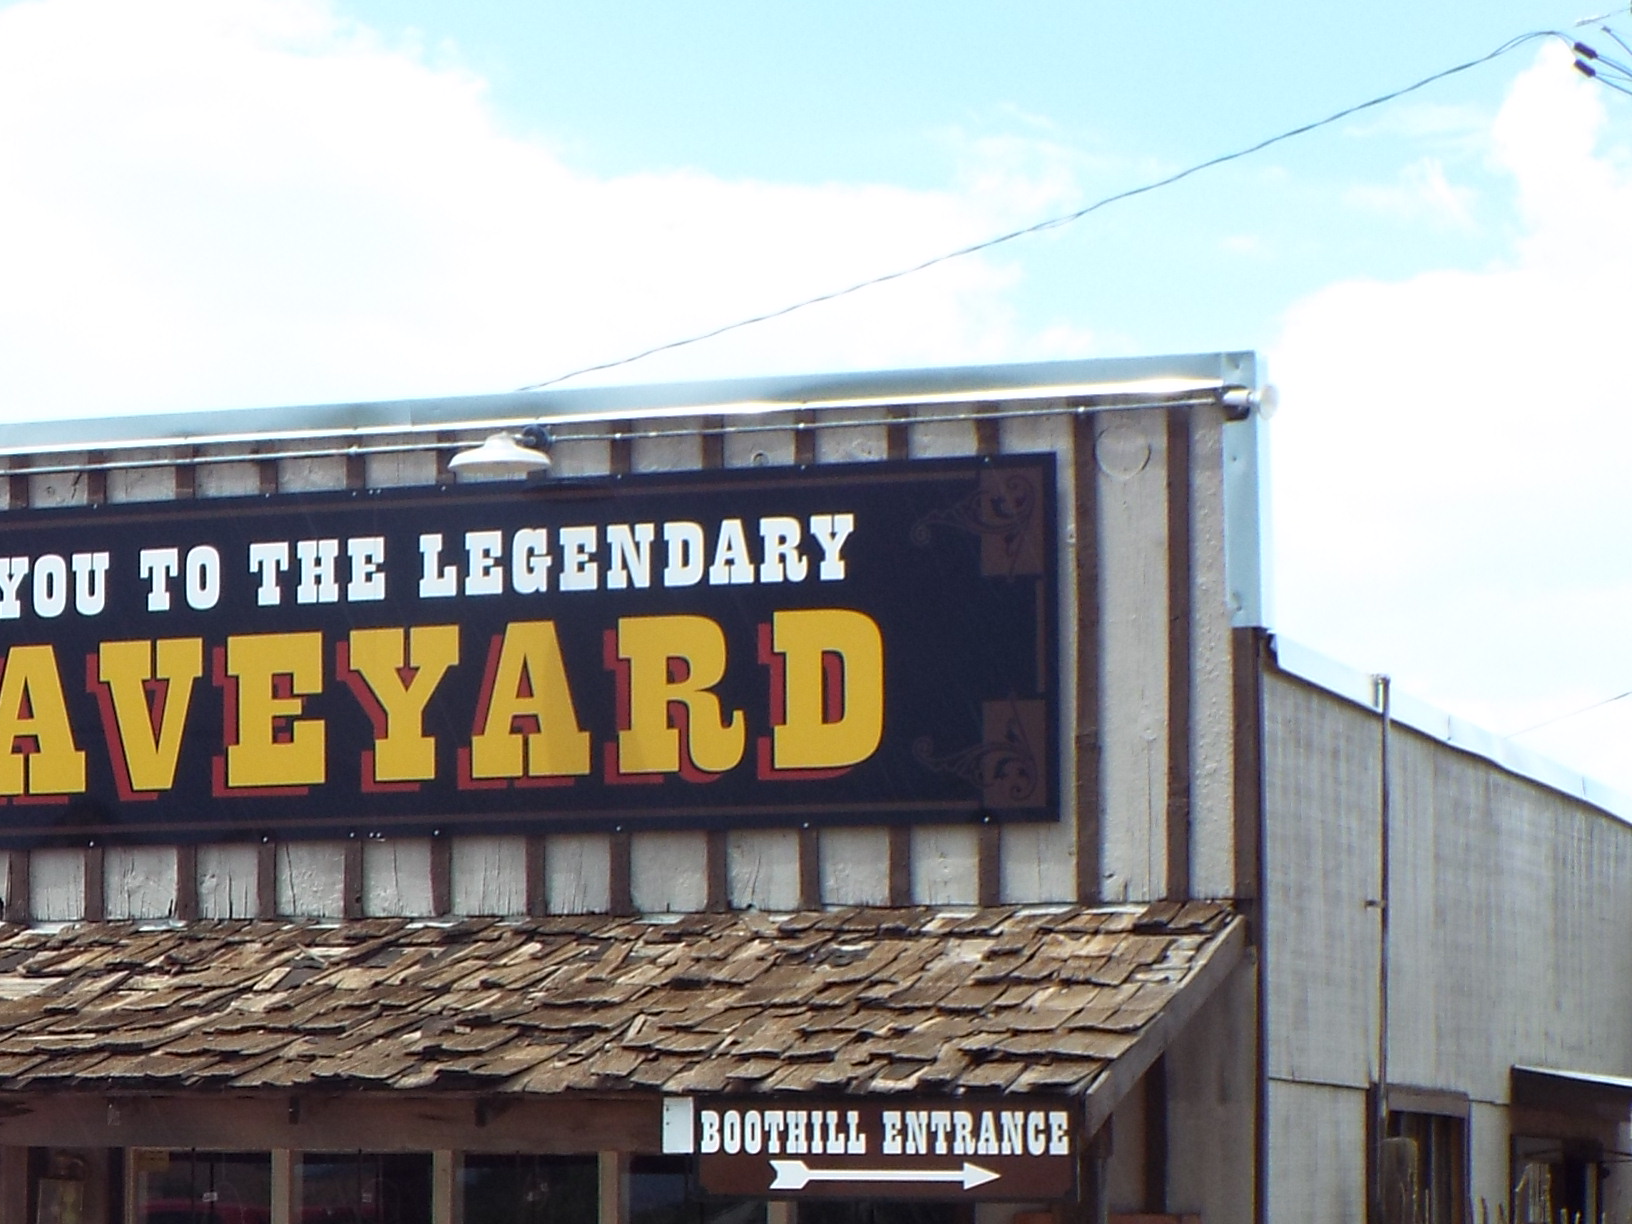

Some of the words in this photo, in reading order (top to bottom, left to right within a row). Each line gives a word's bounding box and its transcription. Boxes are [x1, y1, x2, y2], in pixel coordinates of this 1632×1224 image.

[140, 545, 221, 612] TO
[249, 536, 386, 606] THE
[418, 513, 855, 599] LEGENDARY
[700, 1109, 867, 1155] BOOTHILL
[882, 1110, 1070, 1156] ENTRANCE
